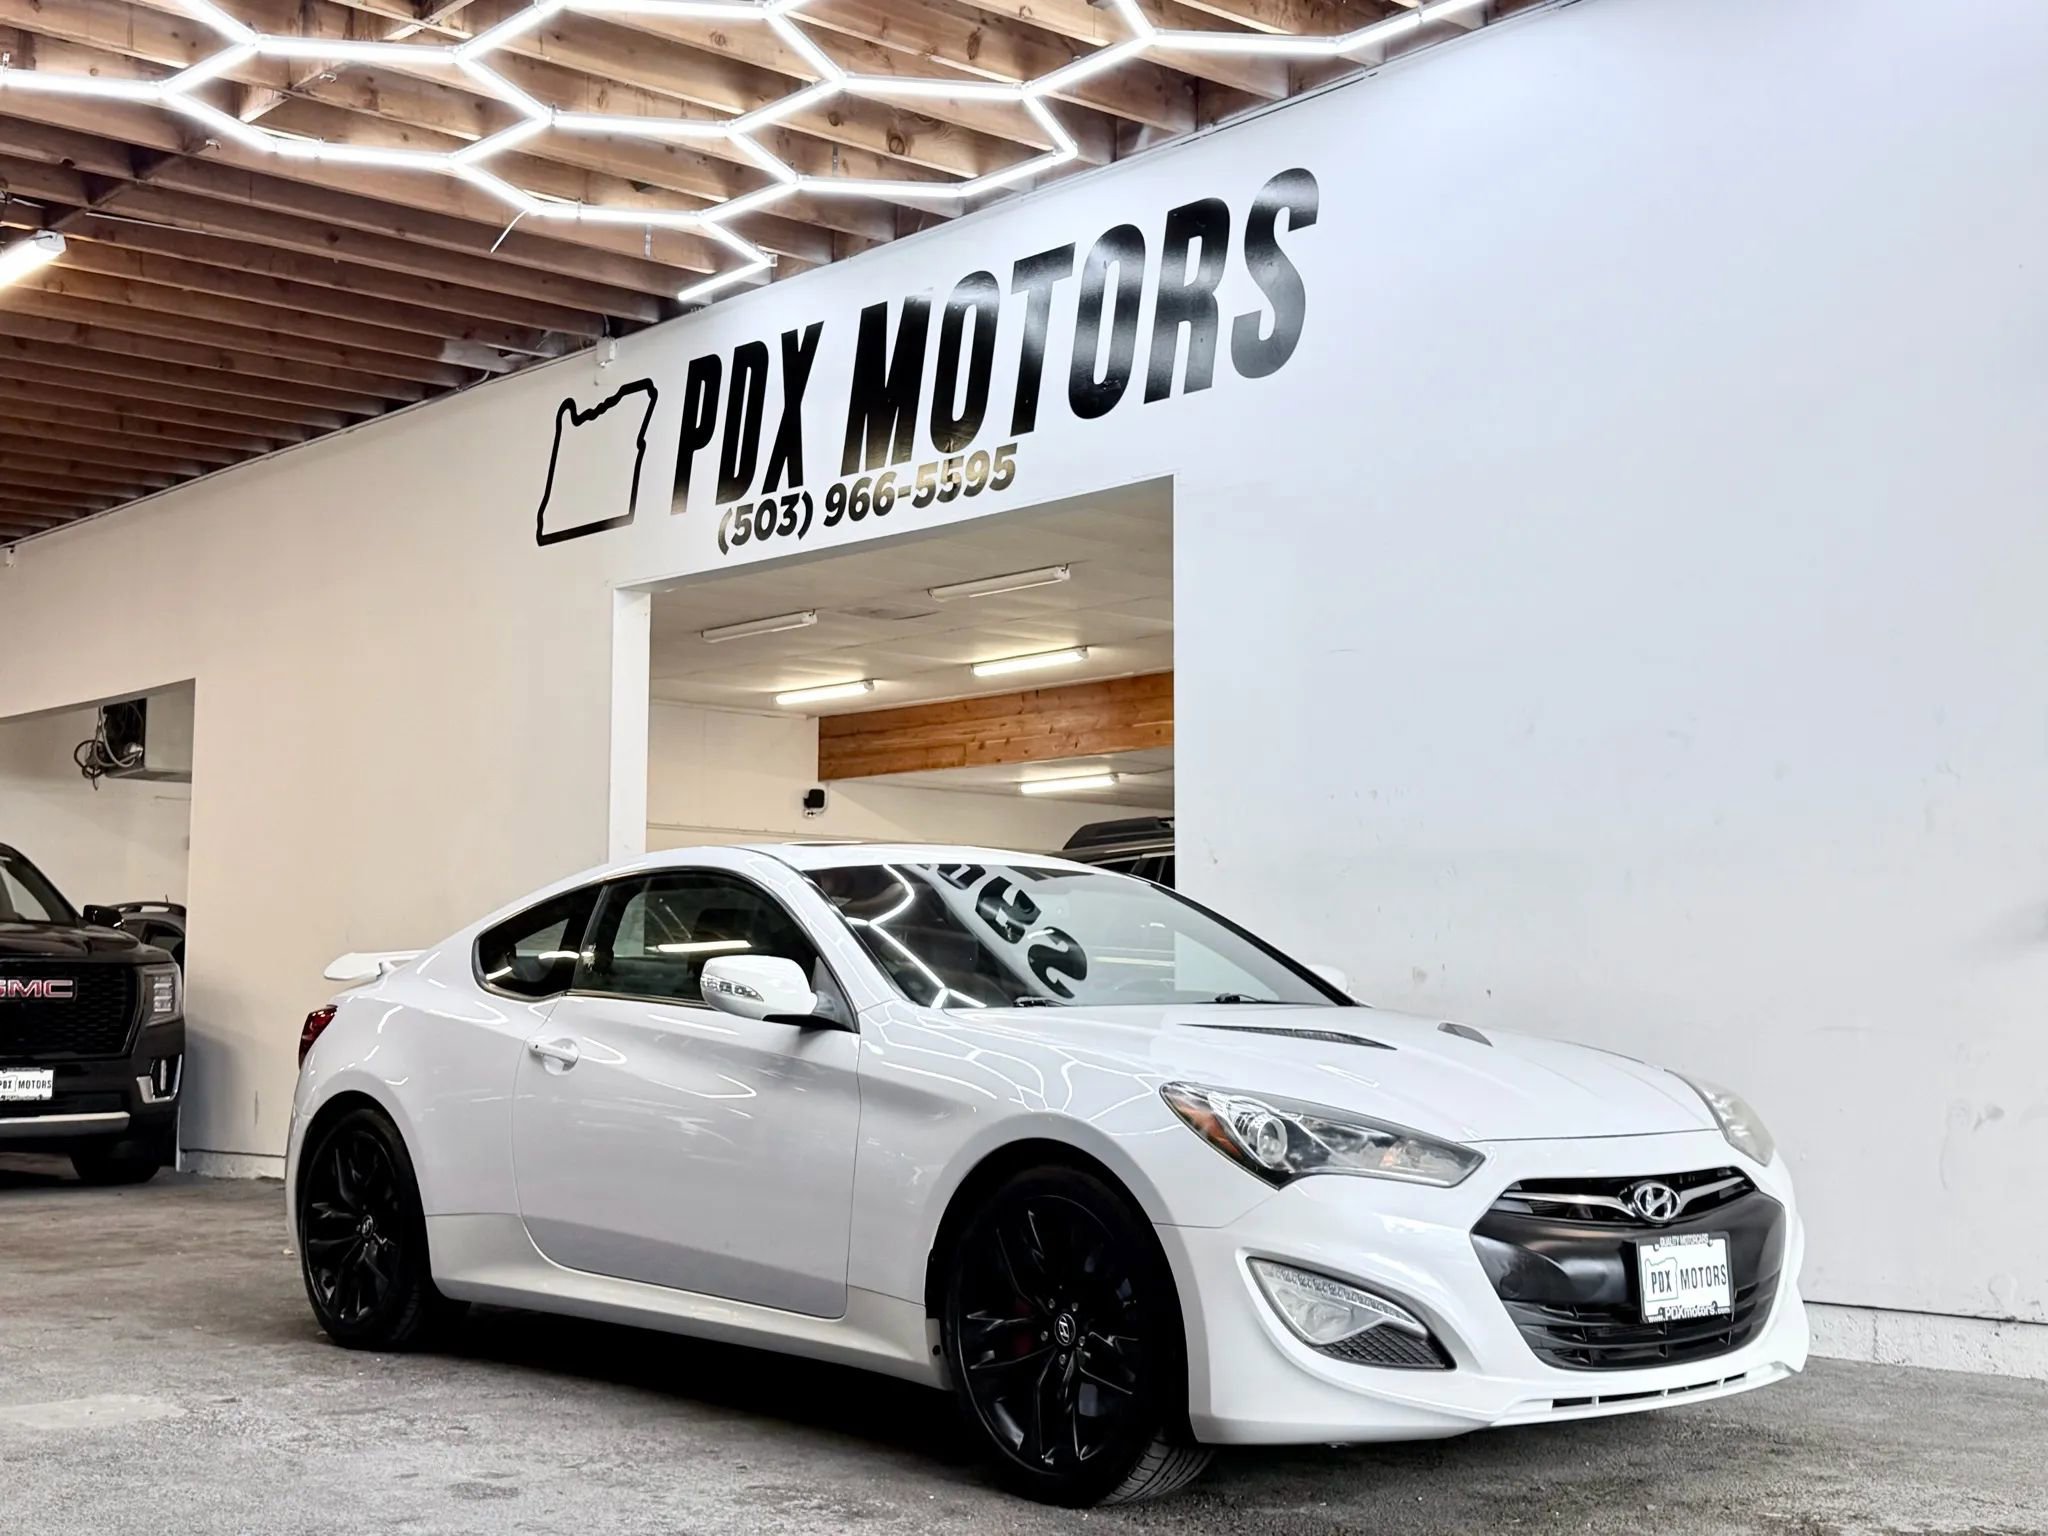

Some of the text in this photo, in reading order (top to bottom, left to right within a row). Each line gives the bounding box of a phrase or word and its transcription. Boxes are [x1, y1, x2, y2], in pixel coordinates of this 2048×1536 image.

[671, 167, 1318, 513] PDX MOTORS
[717, 442, 1018, 556] (503) 966-5595
[0, 979, 73, 998] MC
[18, 1080, 52, 1089] MOTORS
[1651, 1264, 1727, 1294] PDX MOTORS
